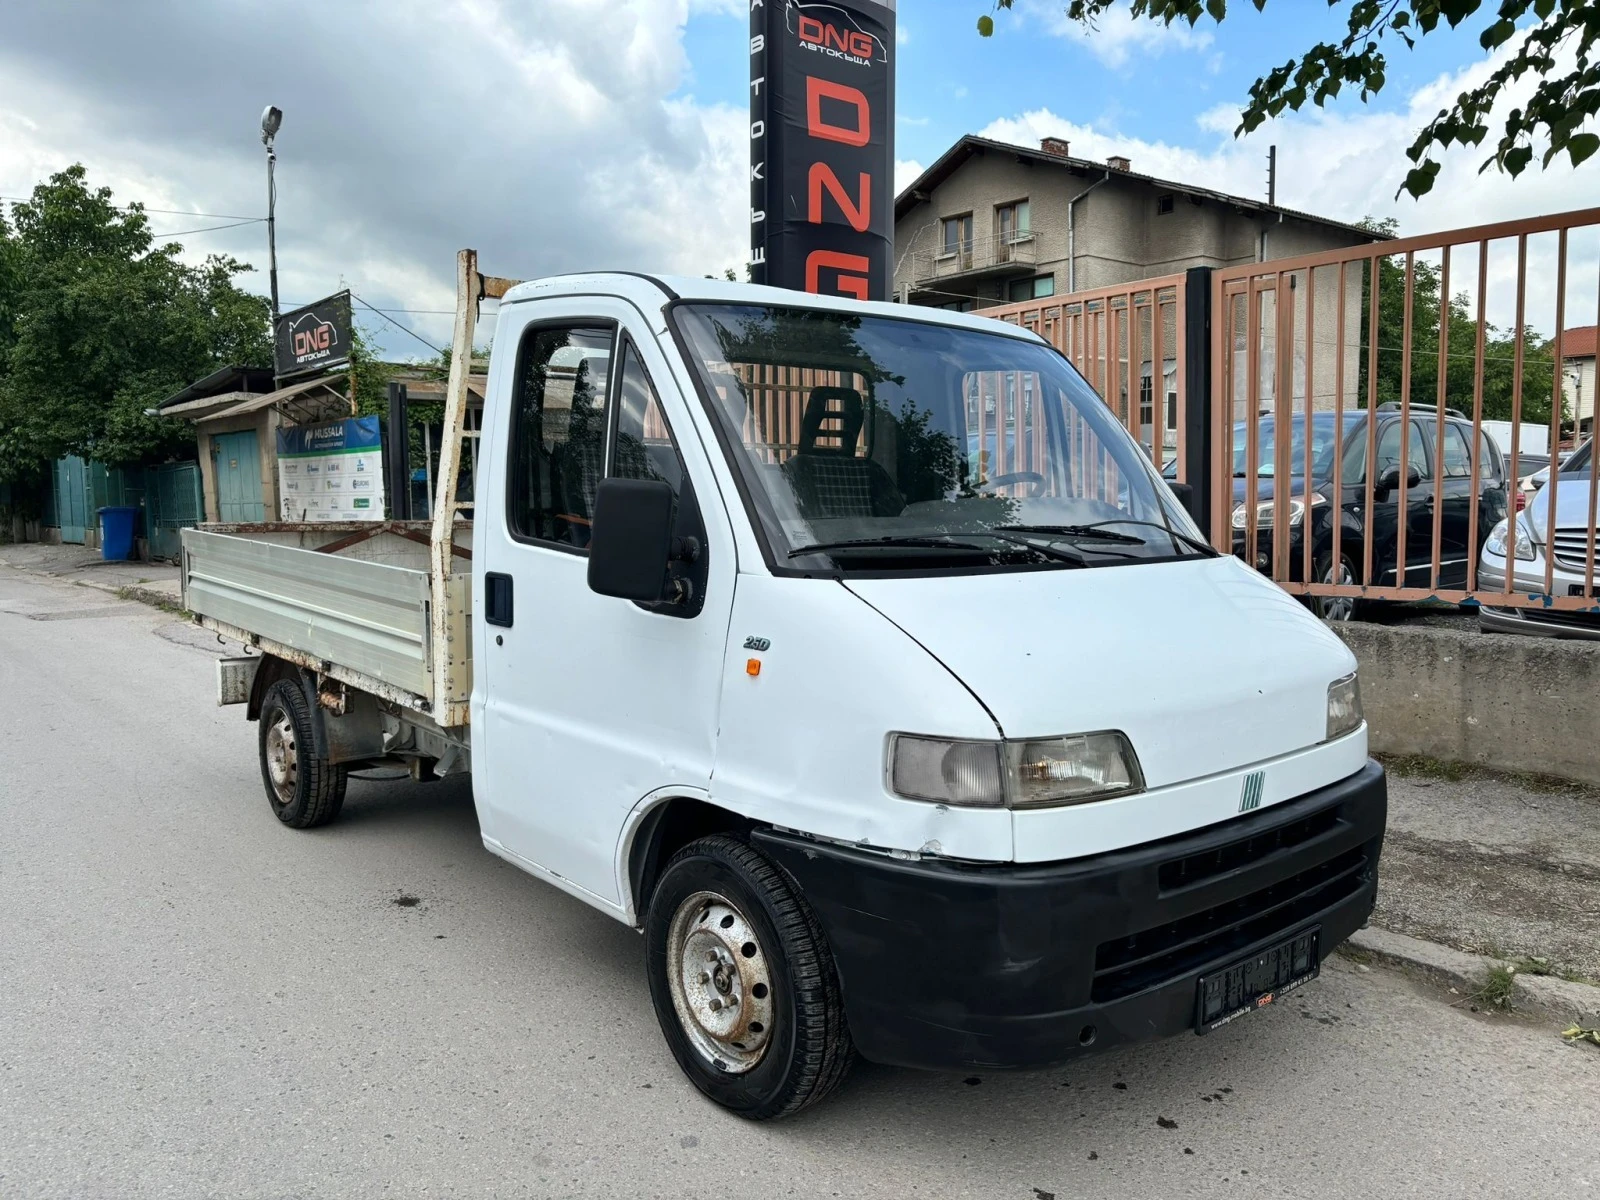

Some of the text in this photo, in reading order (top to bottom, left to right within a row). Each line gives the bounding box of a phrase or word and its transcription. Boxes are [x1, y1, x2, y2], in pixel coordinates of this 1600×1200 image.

[799, 15, 873, 58] DNG
[806, 75, 871, 301] DNG
[295, 324, 330, 356] DNG
